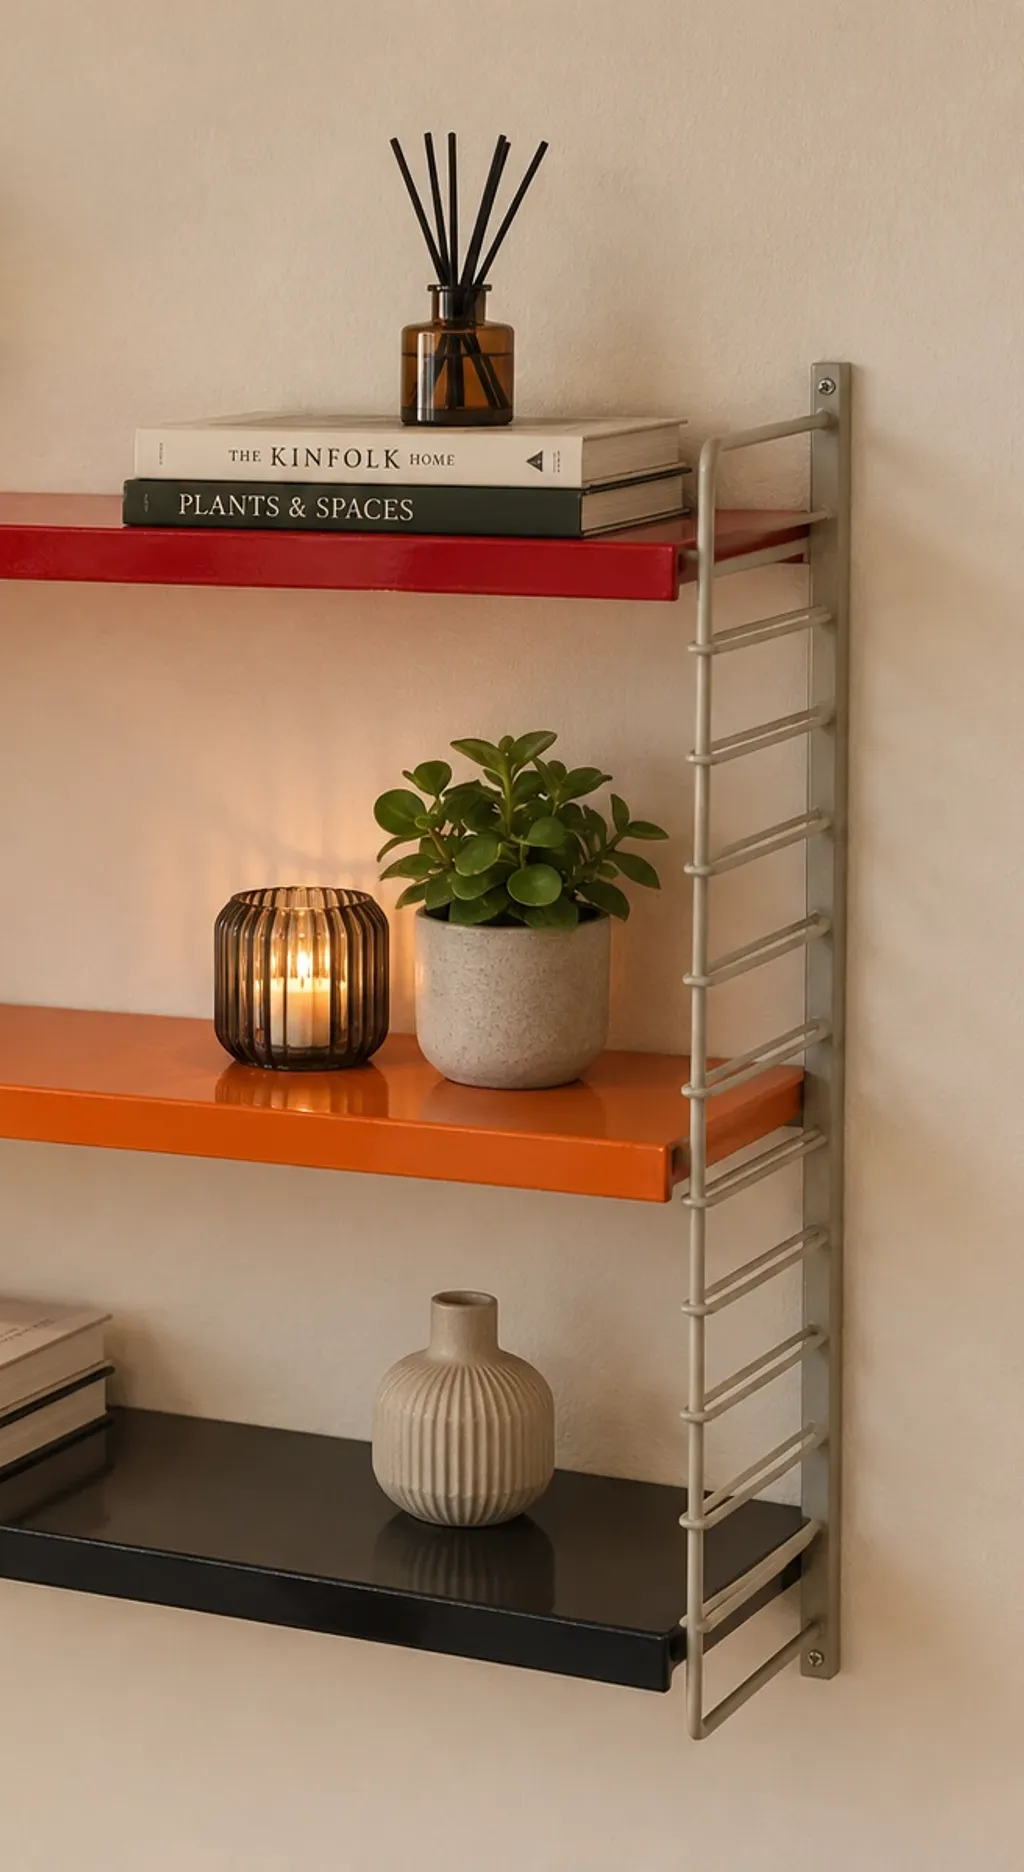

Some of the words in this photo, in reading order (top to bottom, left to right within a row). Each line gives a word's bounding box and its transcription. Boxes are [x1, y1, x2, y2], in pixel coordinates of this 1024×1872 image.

[228, 449, 261, 462] THE
[270, 447, 401, 470] KINFOLK
[409, 453, 455, 466] HOME
[178, 493, 280, 518] PLANTS
[288, 496, 307, 518] &
[316, 496, 414, 521] SPACES
